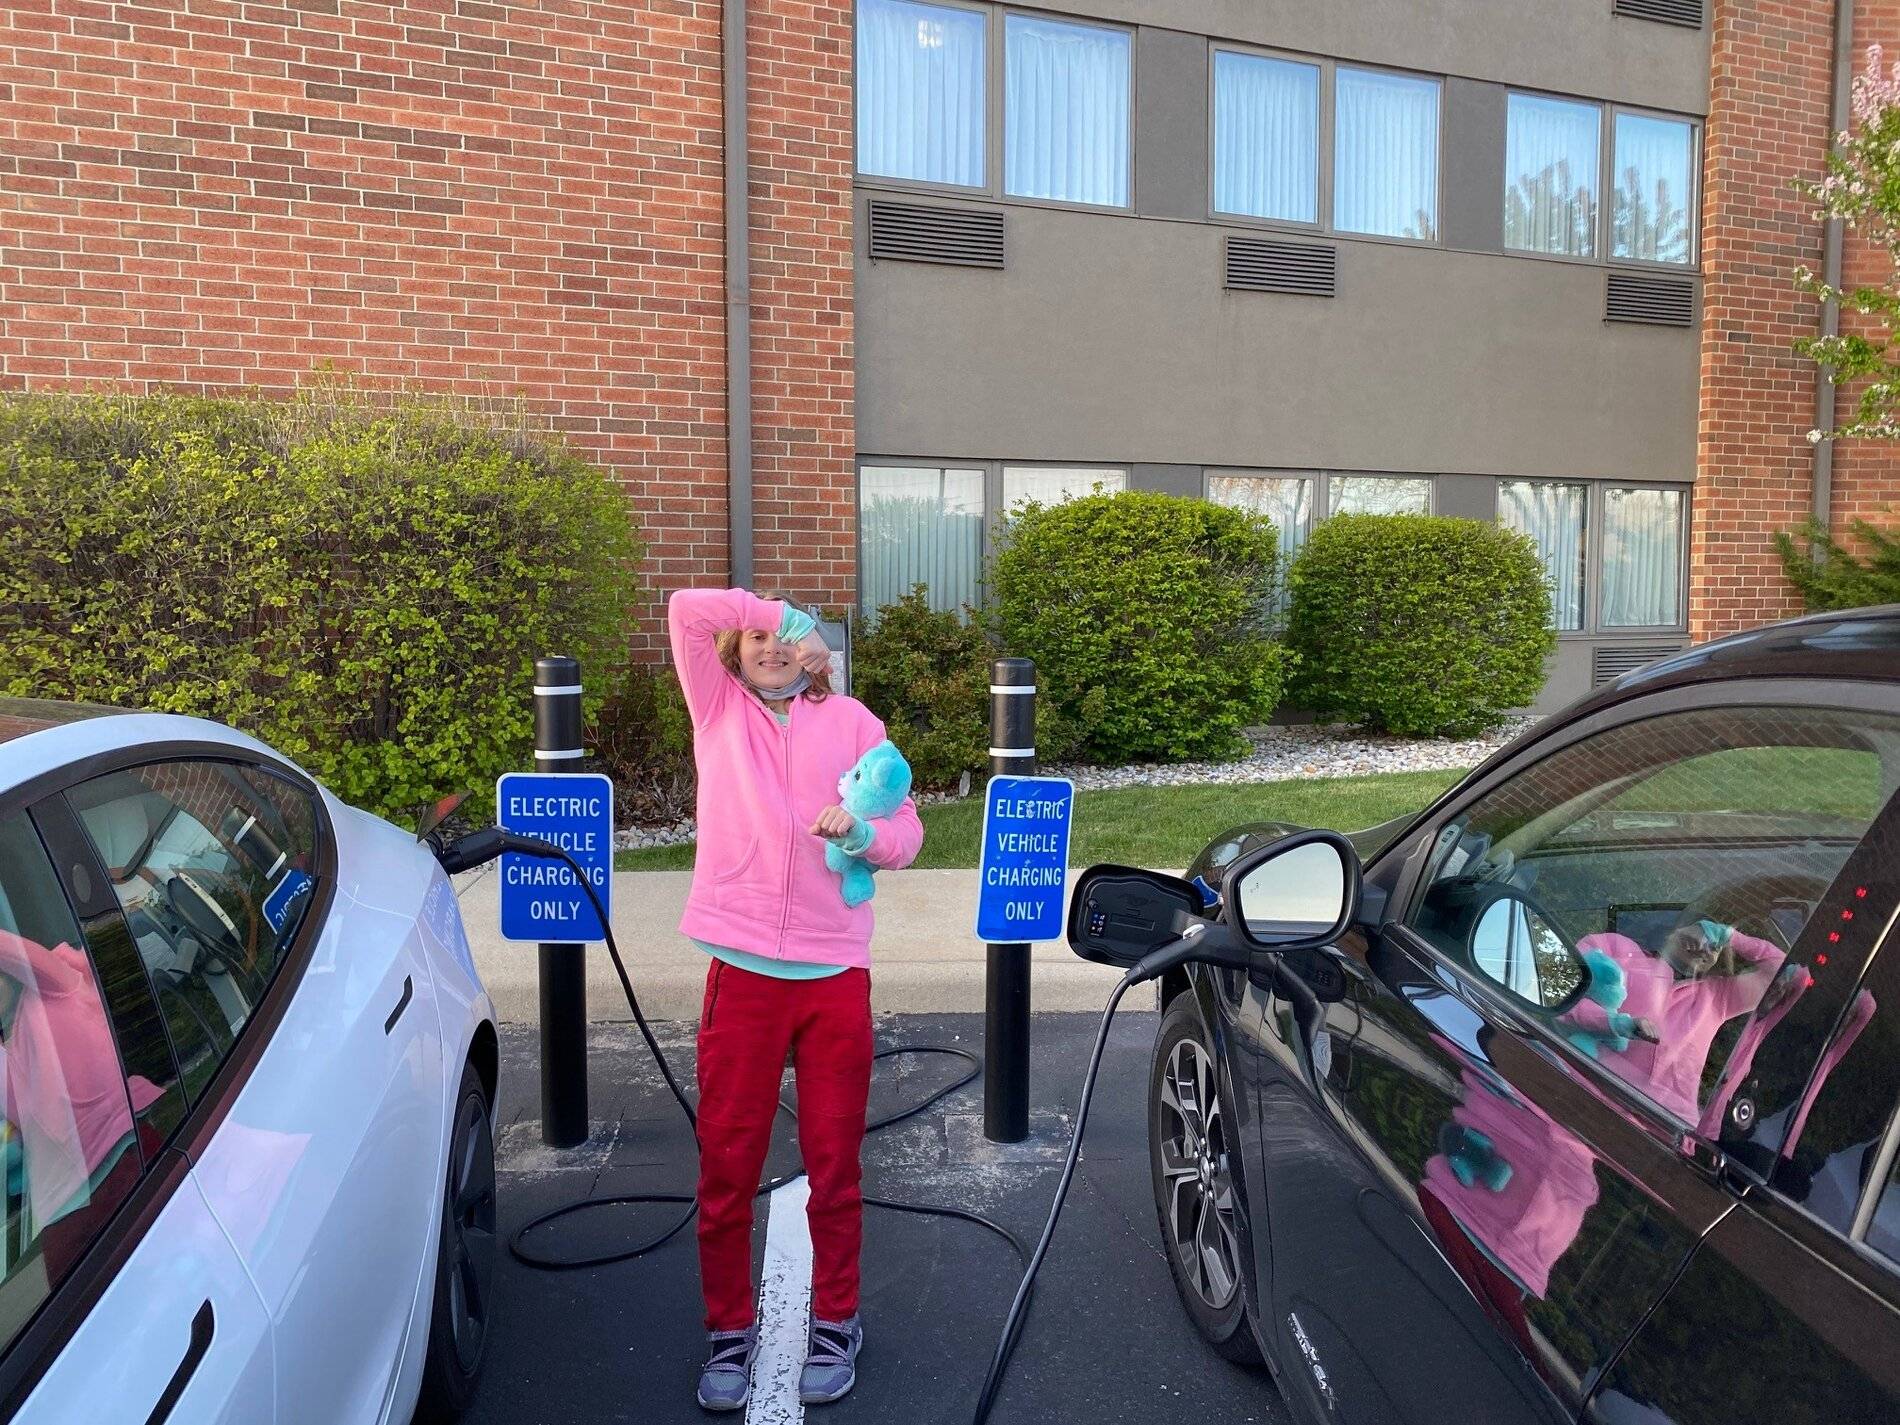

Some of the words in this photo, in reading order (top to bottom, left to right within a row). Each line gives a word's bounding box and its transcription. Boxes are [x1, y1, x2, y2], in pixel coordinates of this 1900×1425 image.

[510, 797, 600, 817] ELECTRIC
[996, 799, 1065, 819] ELECTRIC
[998, 832, 1060, 853] VEHICLE
[987, 866, 1062, 887] CHARGING
[530, 900, 580, 920] ONLY
[1005, 901, 1044, 921] ONLY
